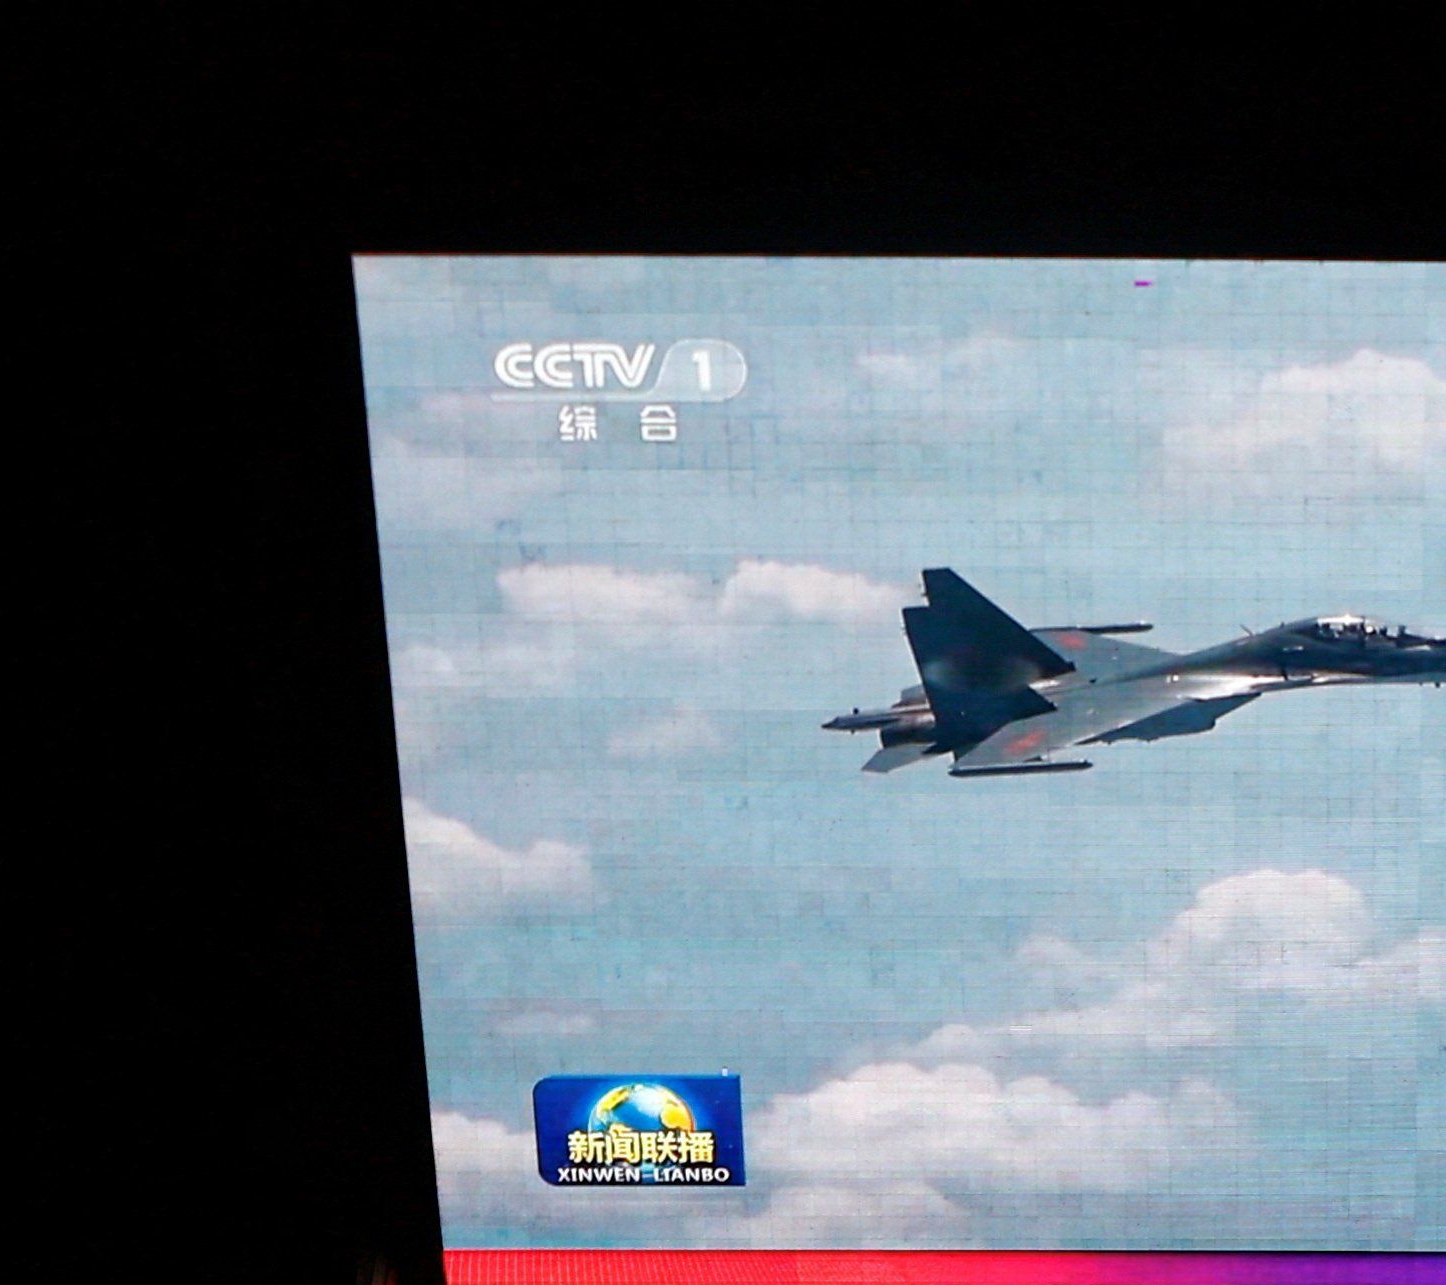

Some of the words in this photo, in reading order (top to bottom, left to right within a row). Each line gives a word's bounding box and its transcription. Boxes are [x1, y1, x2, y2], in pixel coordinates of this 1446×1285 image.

[494, 343, 654, 388] CCTV
[692, 350, 712, 391] 1
[559, 405, 677, 441] 综合
[568, 1130, 715, 1164] 新闻联播
[557, 1167, 641, 1183] XINWEN
[654, 1167, 730, 1183] LIANBO
